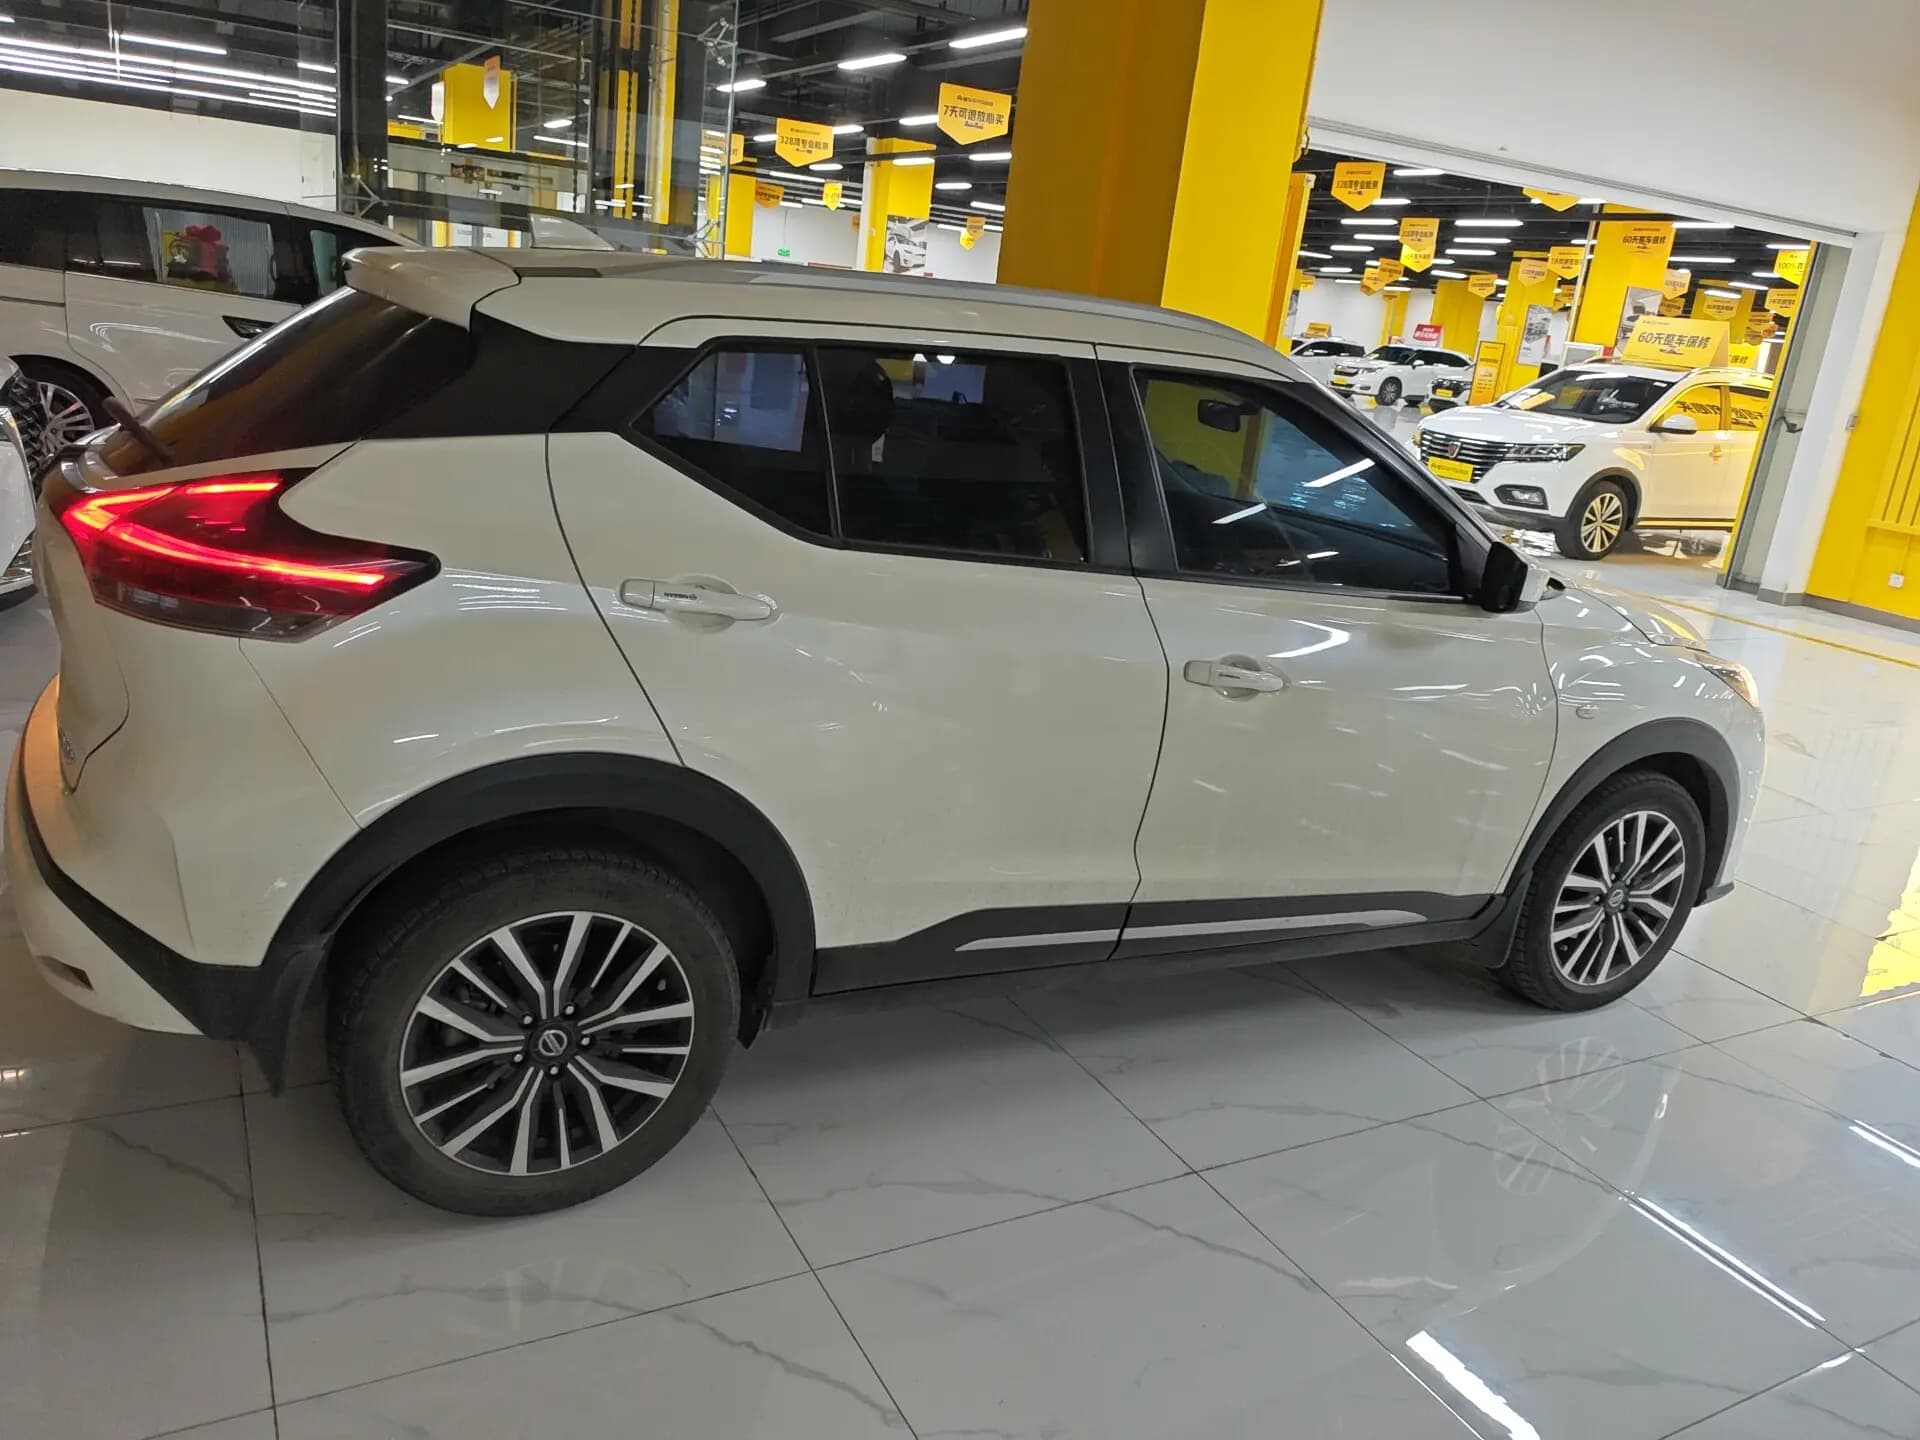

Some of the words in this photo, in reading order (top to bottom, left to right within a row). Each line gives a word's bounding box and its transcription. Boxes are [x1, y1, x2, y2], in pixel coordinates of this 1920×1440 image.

[943, 104, 1005, 126] 7天可退放心买
[1637, 331, 1712, 349] 60天整车保修
